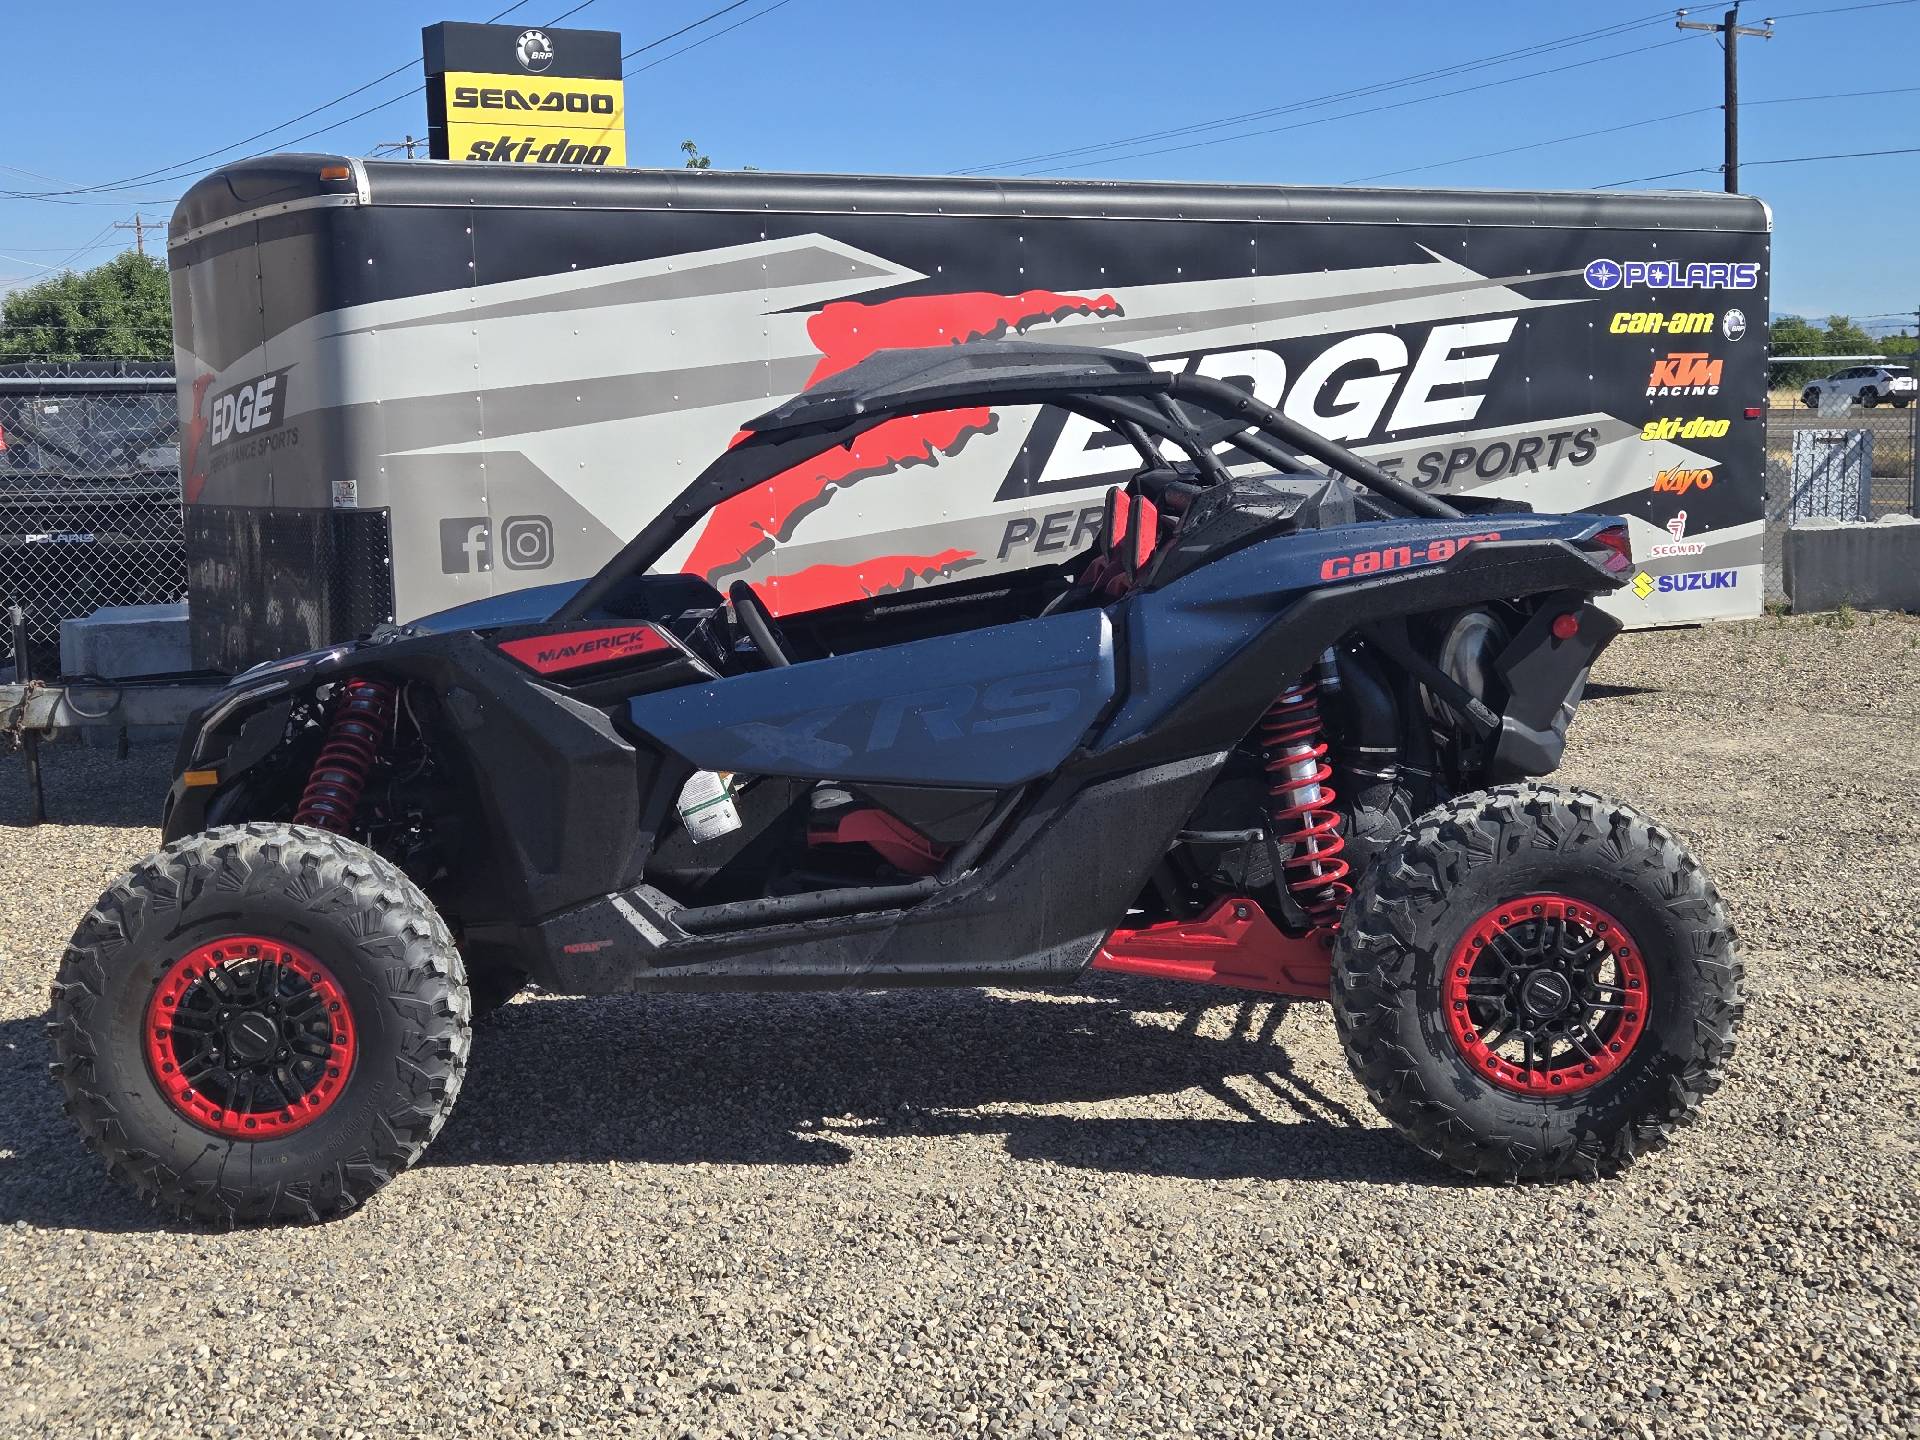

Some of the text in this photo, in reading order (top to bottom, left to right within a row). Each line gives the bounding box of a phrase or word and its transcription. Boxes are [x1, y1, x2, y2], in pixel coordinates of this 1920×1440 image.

[531, 51, 553, 60] BRP
[1623, 261, 1760, 290] POLARIS
[1609, 312, 1714, 334] can-am
[1650, 353, 1723, 386] KTM
[1646, 386, 1719, 397] RACING
[212, 376, 277, 446] EDGE
[258, 427, 299, 457] SPORTS
[1641, 416, 1731, 440] ski-doo
[1412, 427, 1599, 489] SPORTS
[1653, 460, 1714, 494] KAYO
[1652, 544, 1705, 557] SEGWAY
[1658, 571, 1737, 592] SUZUKI
[537, 630, 645, 662] MAVERICK
